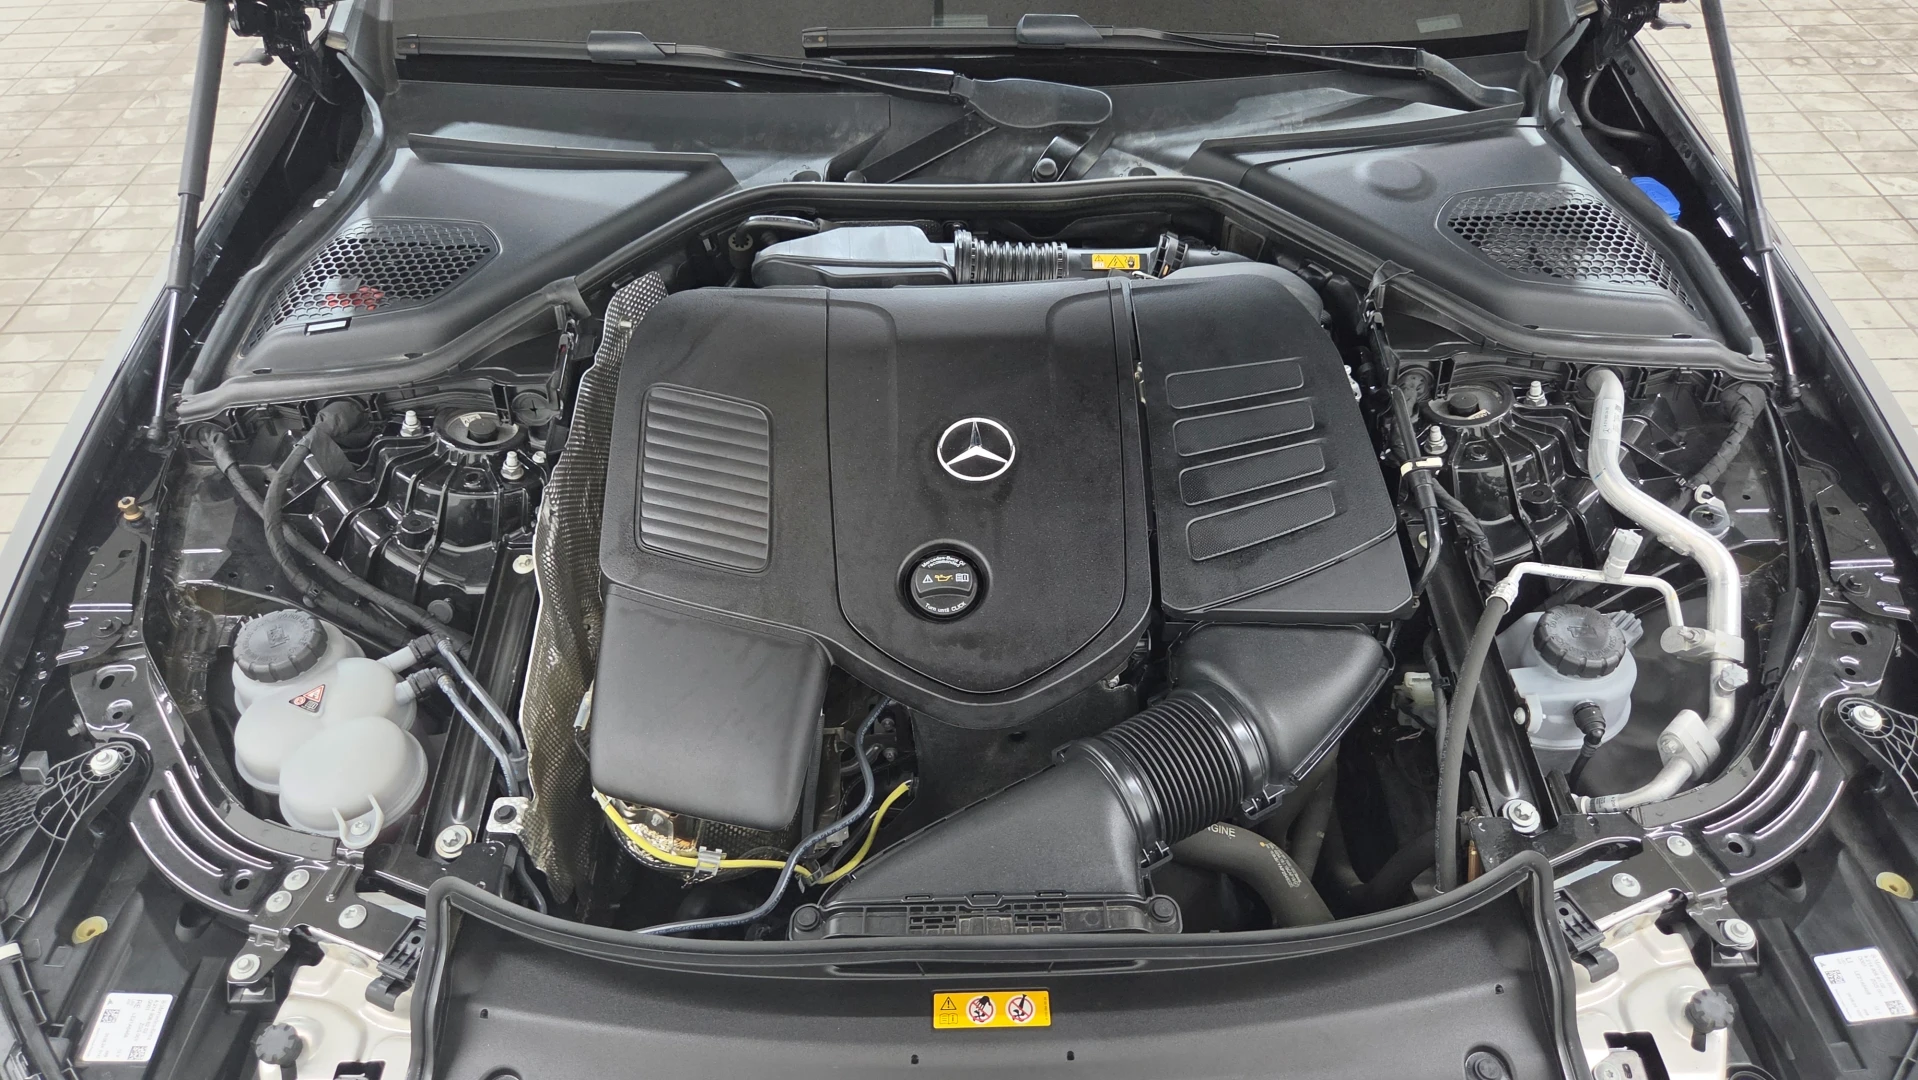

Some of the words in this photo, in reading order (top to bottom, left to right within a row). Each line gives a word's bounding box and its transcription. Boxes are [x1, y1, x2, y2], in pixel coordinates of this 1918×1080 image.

[925, 602, 937, 612] Turn
[951, 601, 967, 612] CLICK
[1207, 823, 1236, 837] GINE
